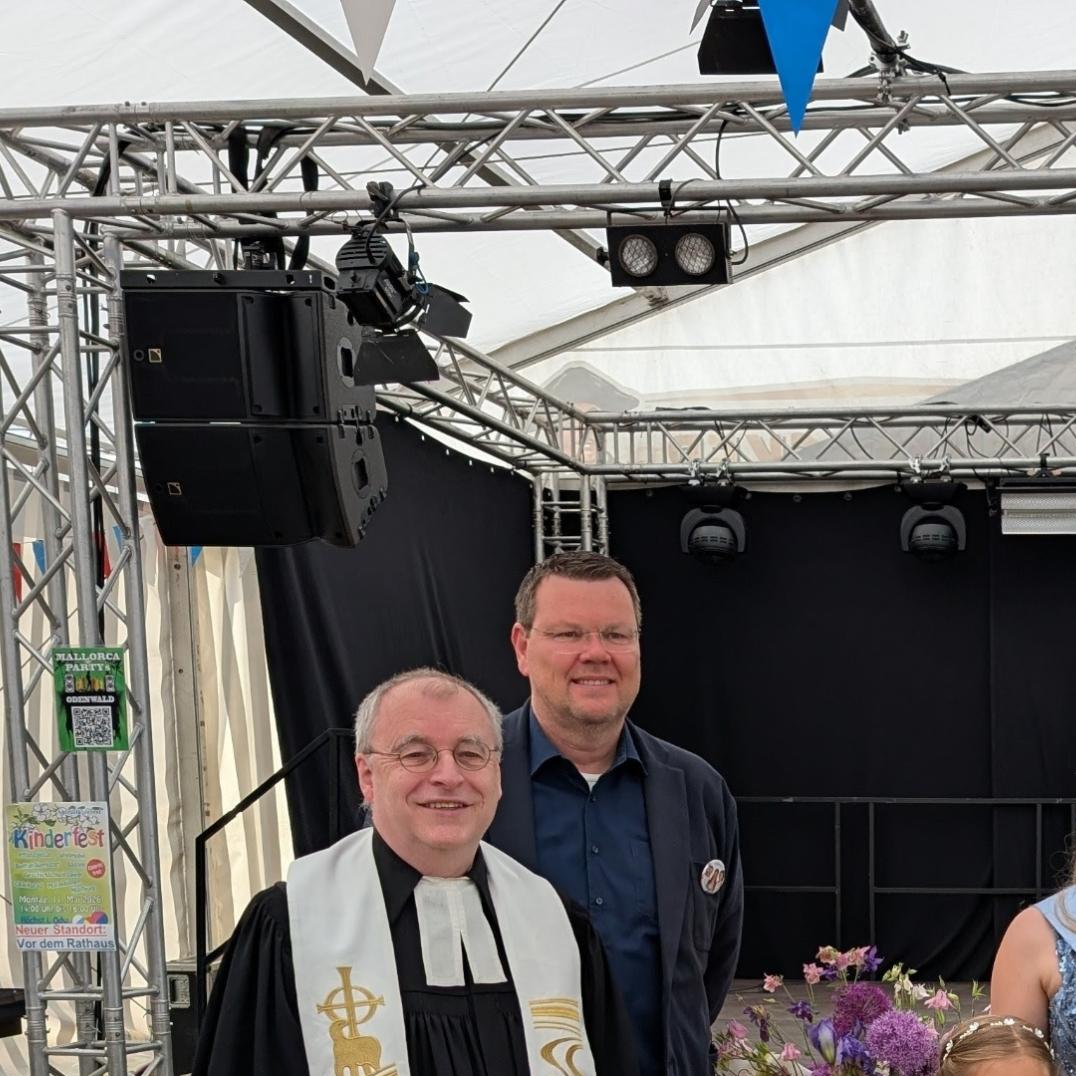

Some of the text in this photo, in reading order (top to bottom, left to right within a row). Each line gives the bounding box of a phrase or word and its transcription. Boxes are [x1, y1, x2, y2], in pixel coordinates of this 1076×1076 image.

[55, 652, 120, 661] MALLORCA
[66, 695, 115, 703] ODENWALD
[13, 825, 105, 850] Kinderfest
[15, 924, 107, 935] Neuer Standort:
[16, 938, 115, 948] Vor dem Rathaus
